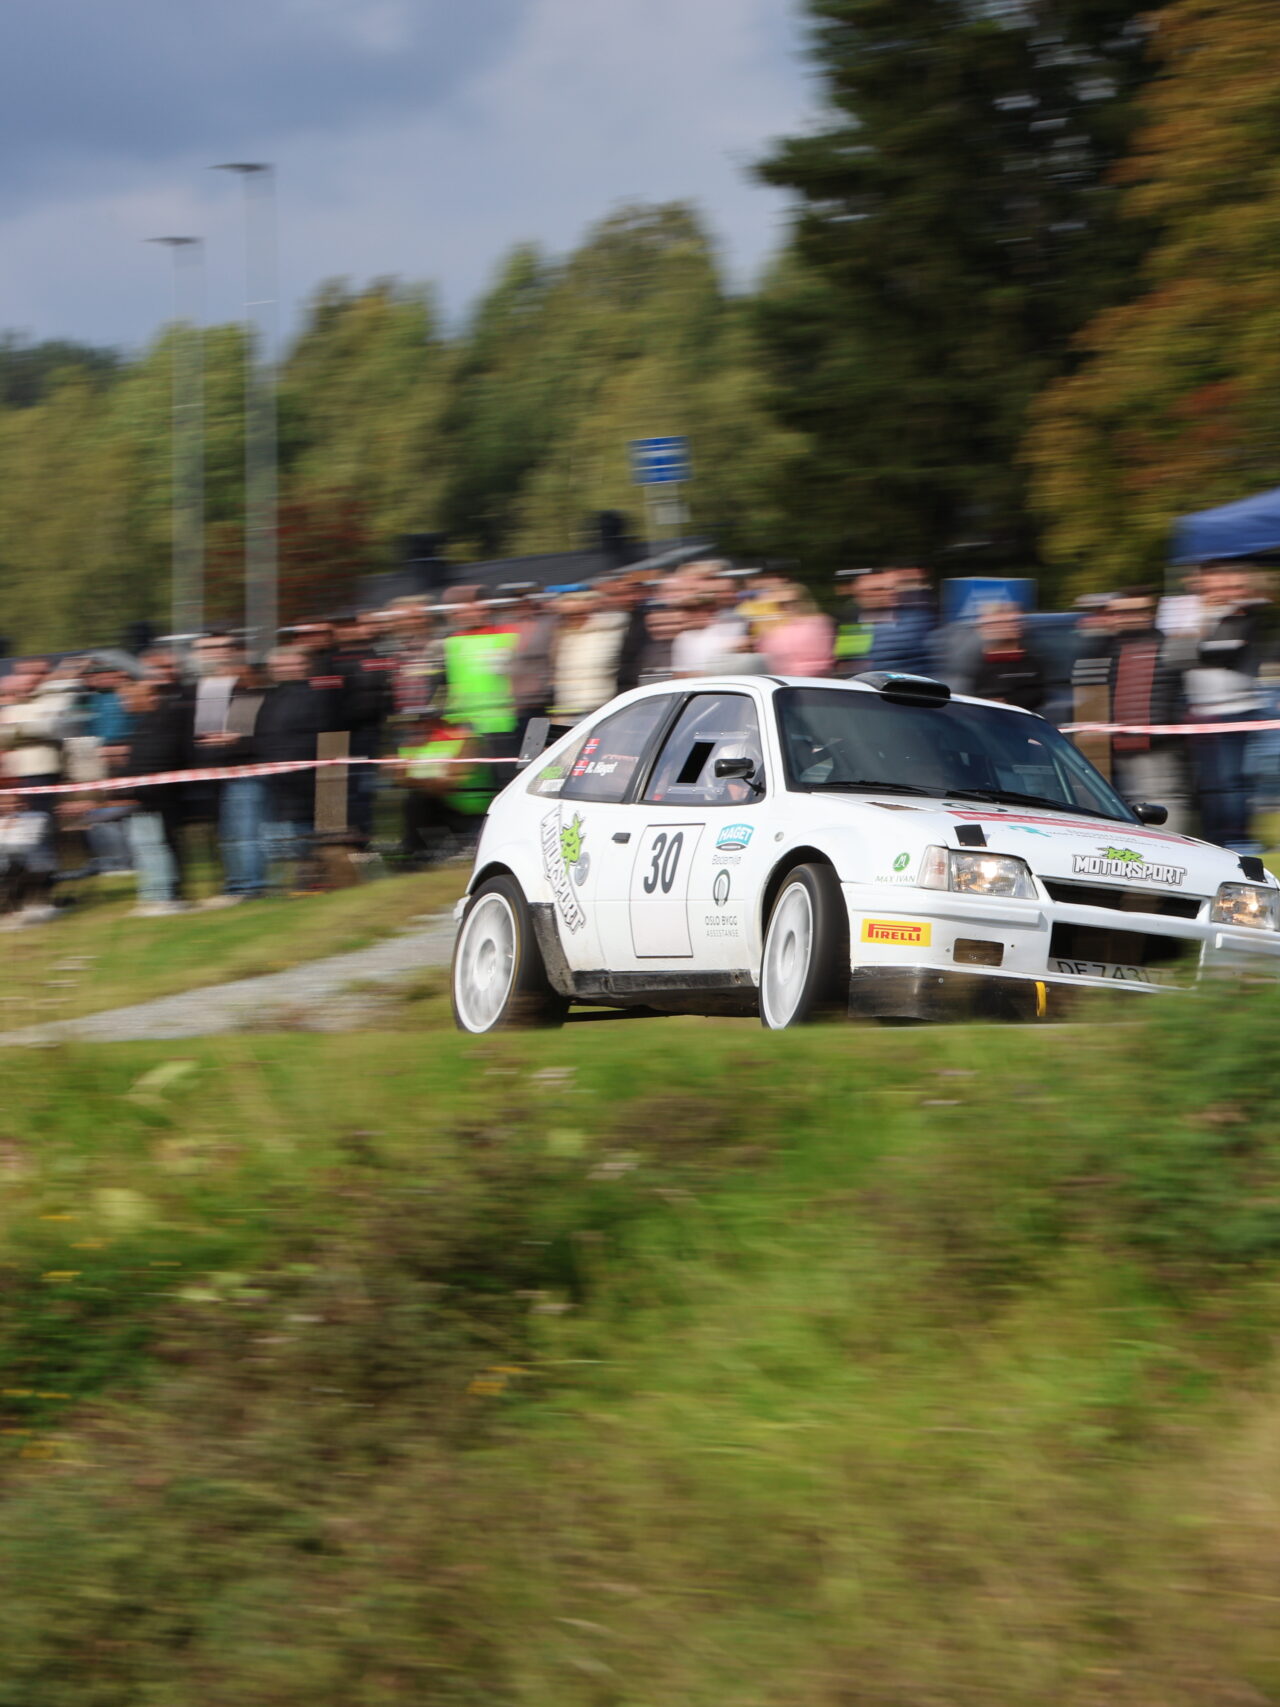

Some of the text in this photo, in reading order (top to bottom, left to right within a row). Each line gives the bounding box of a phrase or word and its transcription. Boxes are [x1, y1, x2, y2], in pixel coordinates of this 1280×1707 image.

[719, 826, 753, 841] HAGET
[643, 831, 684, 894] 30
[1072, 854, 1186, 886] MOTORSPORT
[875, 875, 916, 883] MAX IVAN
[705, 915, 738, 926] OSLO BYGG
[867, 923, 922, 941] PIRELLI
